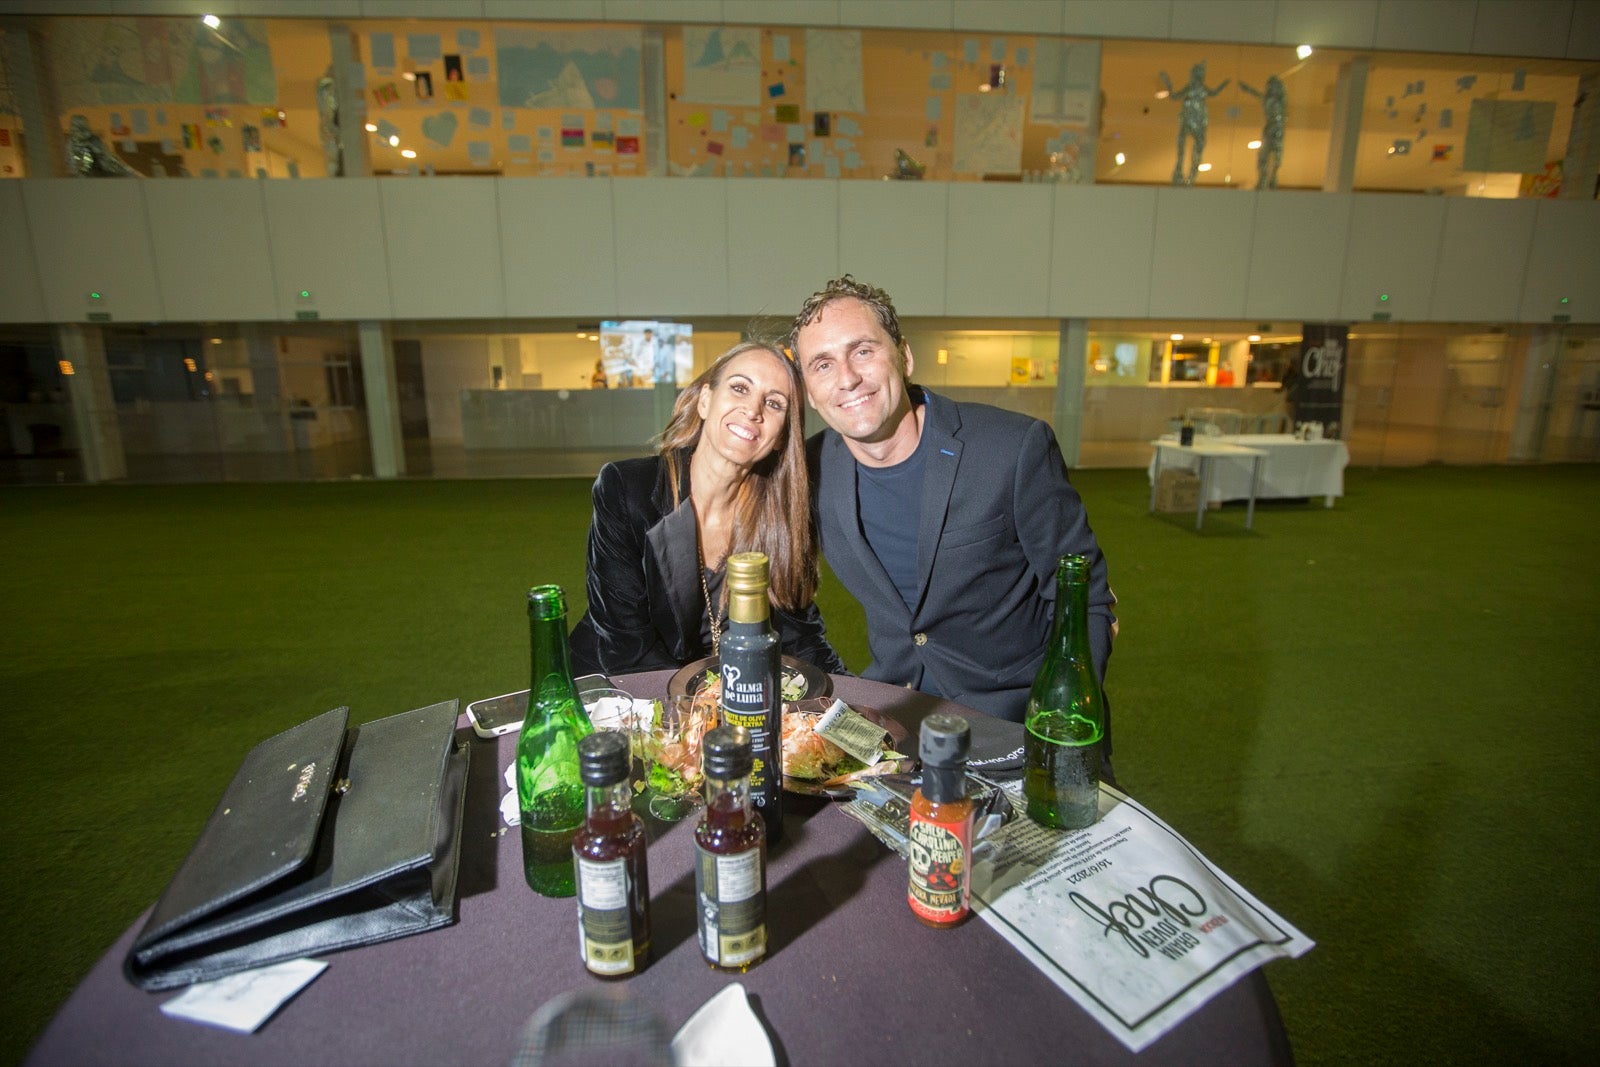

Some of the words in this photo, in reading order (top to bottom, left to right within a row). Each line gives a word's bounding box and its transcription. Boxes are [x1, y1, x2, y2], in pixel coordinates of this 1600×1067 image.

[748, 714, 766, 722] OLIVA
[911, 827, 957, 851] CAROLINA
[919, 821, 946, 838] SALSA
[931, 842, 963, 864] REAPER
[1066, 859, 1113, 884] 16/6/2021
[1068, 874, 1207, 958] Chef
[1136, 914, 1189, 949] JOVEN
[1152, 929, 1200, 961] GRANA
